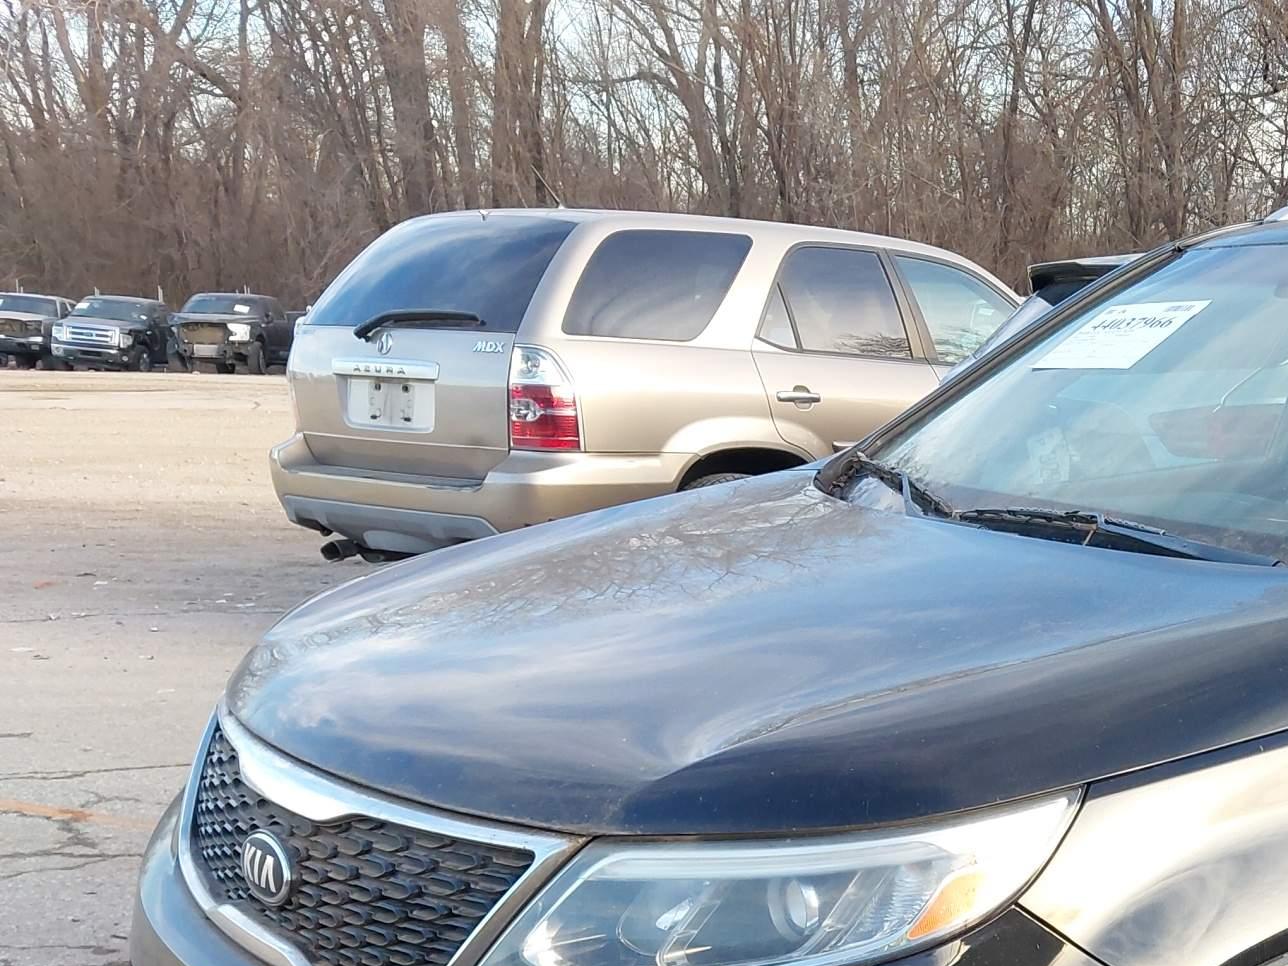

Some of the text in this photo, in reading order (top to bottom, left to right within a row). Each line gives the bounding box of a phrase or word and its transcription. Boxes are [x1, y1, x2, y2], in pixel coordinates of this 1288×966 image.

[1091, 316, 1176, 331] 44037966
[472, 340, 505, 354] MDX
[352, 363, 407, 376] ACURA
[243, 842, 277, 894] KIA
